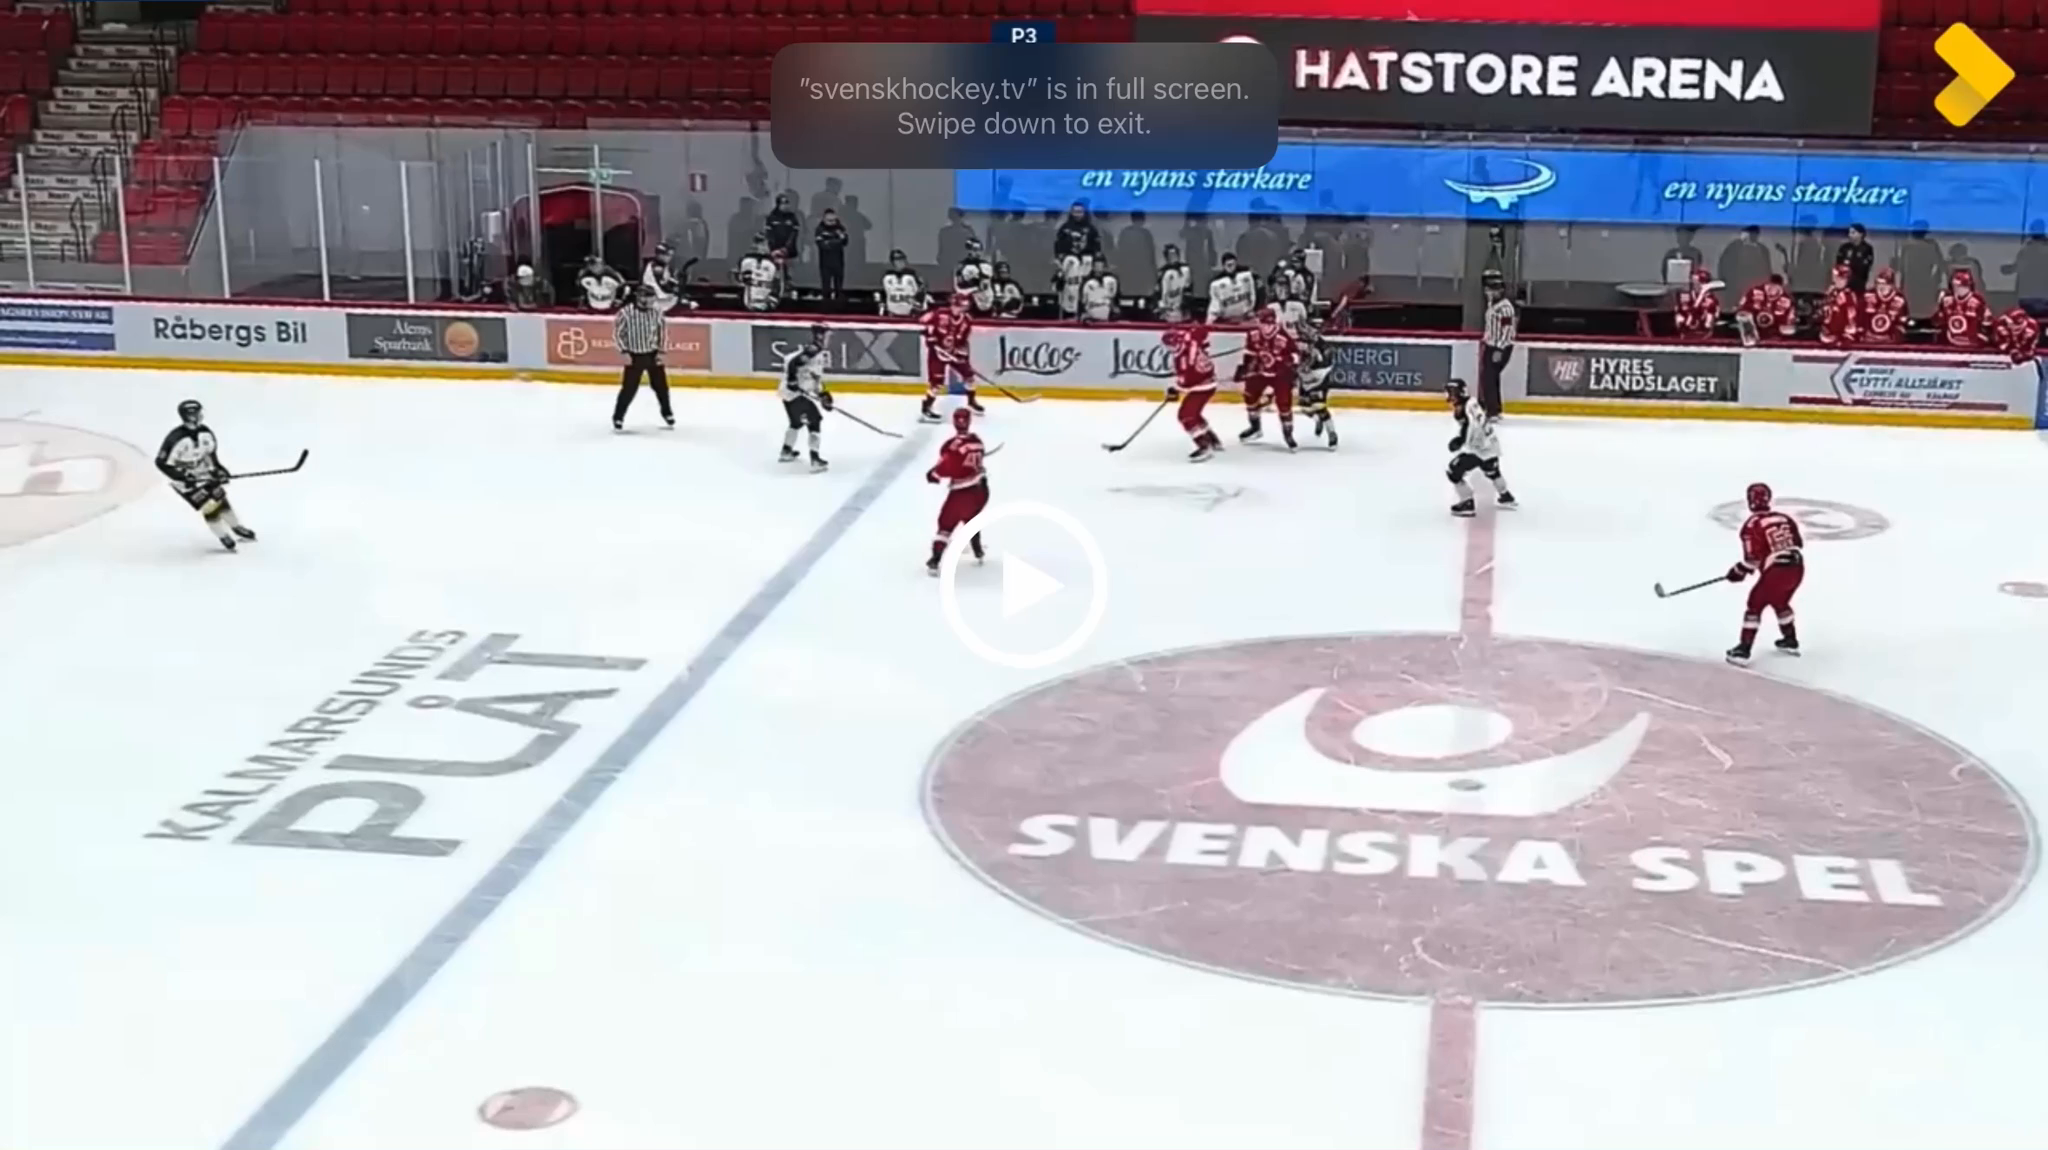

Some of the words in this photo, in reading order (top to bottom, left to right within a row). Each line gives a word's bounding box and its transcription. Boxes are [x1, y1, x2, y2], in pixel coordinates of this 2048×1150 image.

[1295, 49, 1578, 96] HATSTORE
[1591, 56, 1785, 101] ARENA
[1082, 170, 1112, 187] en
[1121, 169, 1197, 196] nyans
[1203, 166, 1312, 190] starkare
[1664, 180, 1697, 199] en
[1704, 182, 1786, 209] nyans
[1791, 175, 1908, 204] starkare
[153, 316, 266, 347] Råbergs
[276, 321, 307, 343] Bil
[374, 336, 432, 354] Sparbank
[1332, 348, 1399, 366] NERGI
[1590, 357, 1654, 375] HYRES
[1376, 371, 1423, 386] SVETS
[1589, 374, 1719, 393] LANDSLAGET
[143, 629, 467, 841] KALMARSUNDS
[231, 633, 648, 857] PLÅT
[1008, 814, 1587, 888] SVENSKA
[1630, 846, 1943, 907] SPEL
